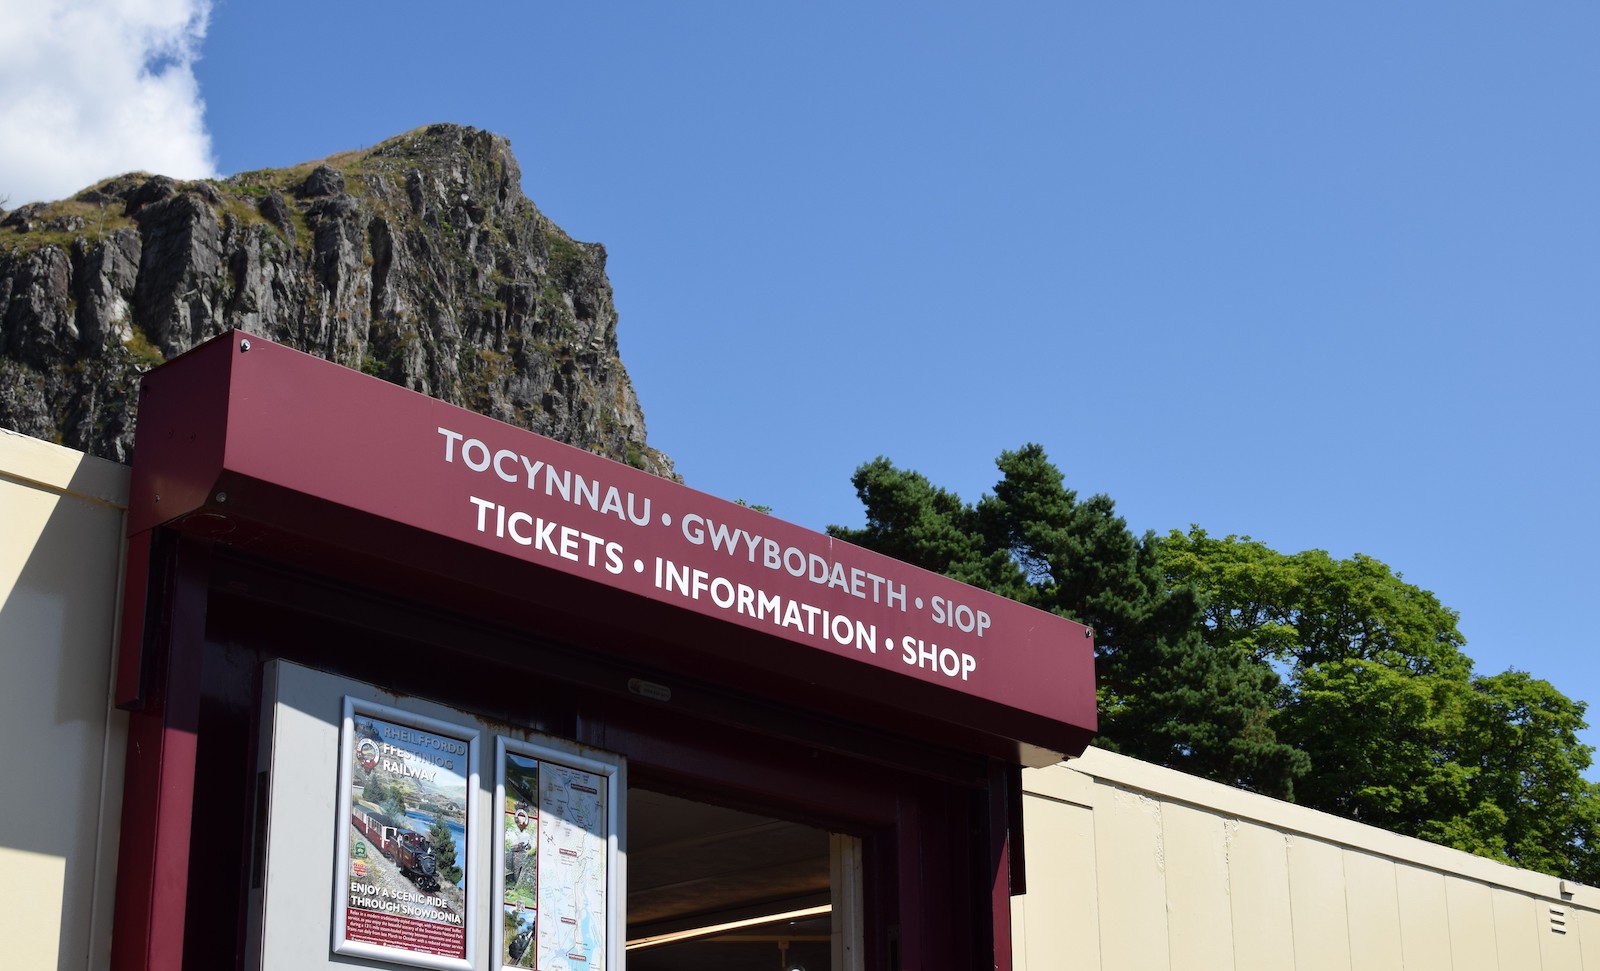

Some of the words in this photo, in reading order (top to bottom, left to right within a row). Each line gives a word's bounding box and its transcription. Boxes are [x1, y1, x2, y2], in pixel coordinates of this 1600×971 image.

[437, 426, 651, 527] TOCYNNAU
[681, 513, 907, 612] GWYBODAETH
[931, 595, 991, 638] SIOP
[469, 495, 624, 575] TICKETS
[655, 556, 877, 654] INFORMATION
[901, 635, 976, 681] SHOP
[384, 725, 465, 756] RHEILFFORDD
[383, 742, 454, 769] FFESTINIOG
[383, 760, 437, 782] RAILWAY
[350, 881, 381, 896] ENJOY
[381, 888, 390, 898] A
[391, 889, 426, 904] SCENIC
[426, 895, 448, 909] RIDE
[350, 895, 400, 913] THROUGH
[401, 904, 462, 924] SNOWDONIA
